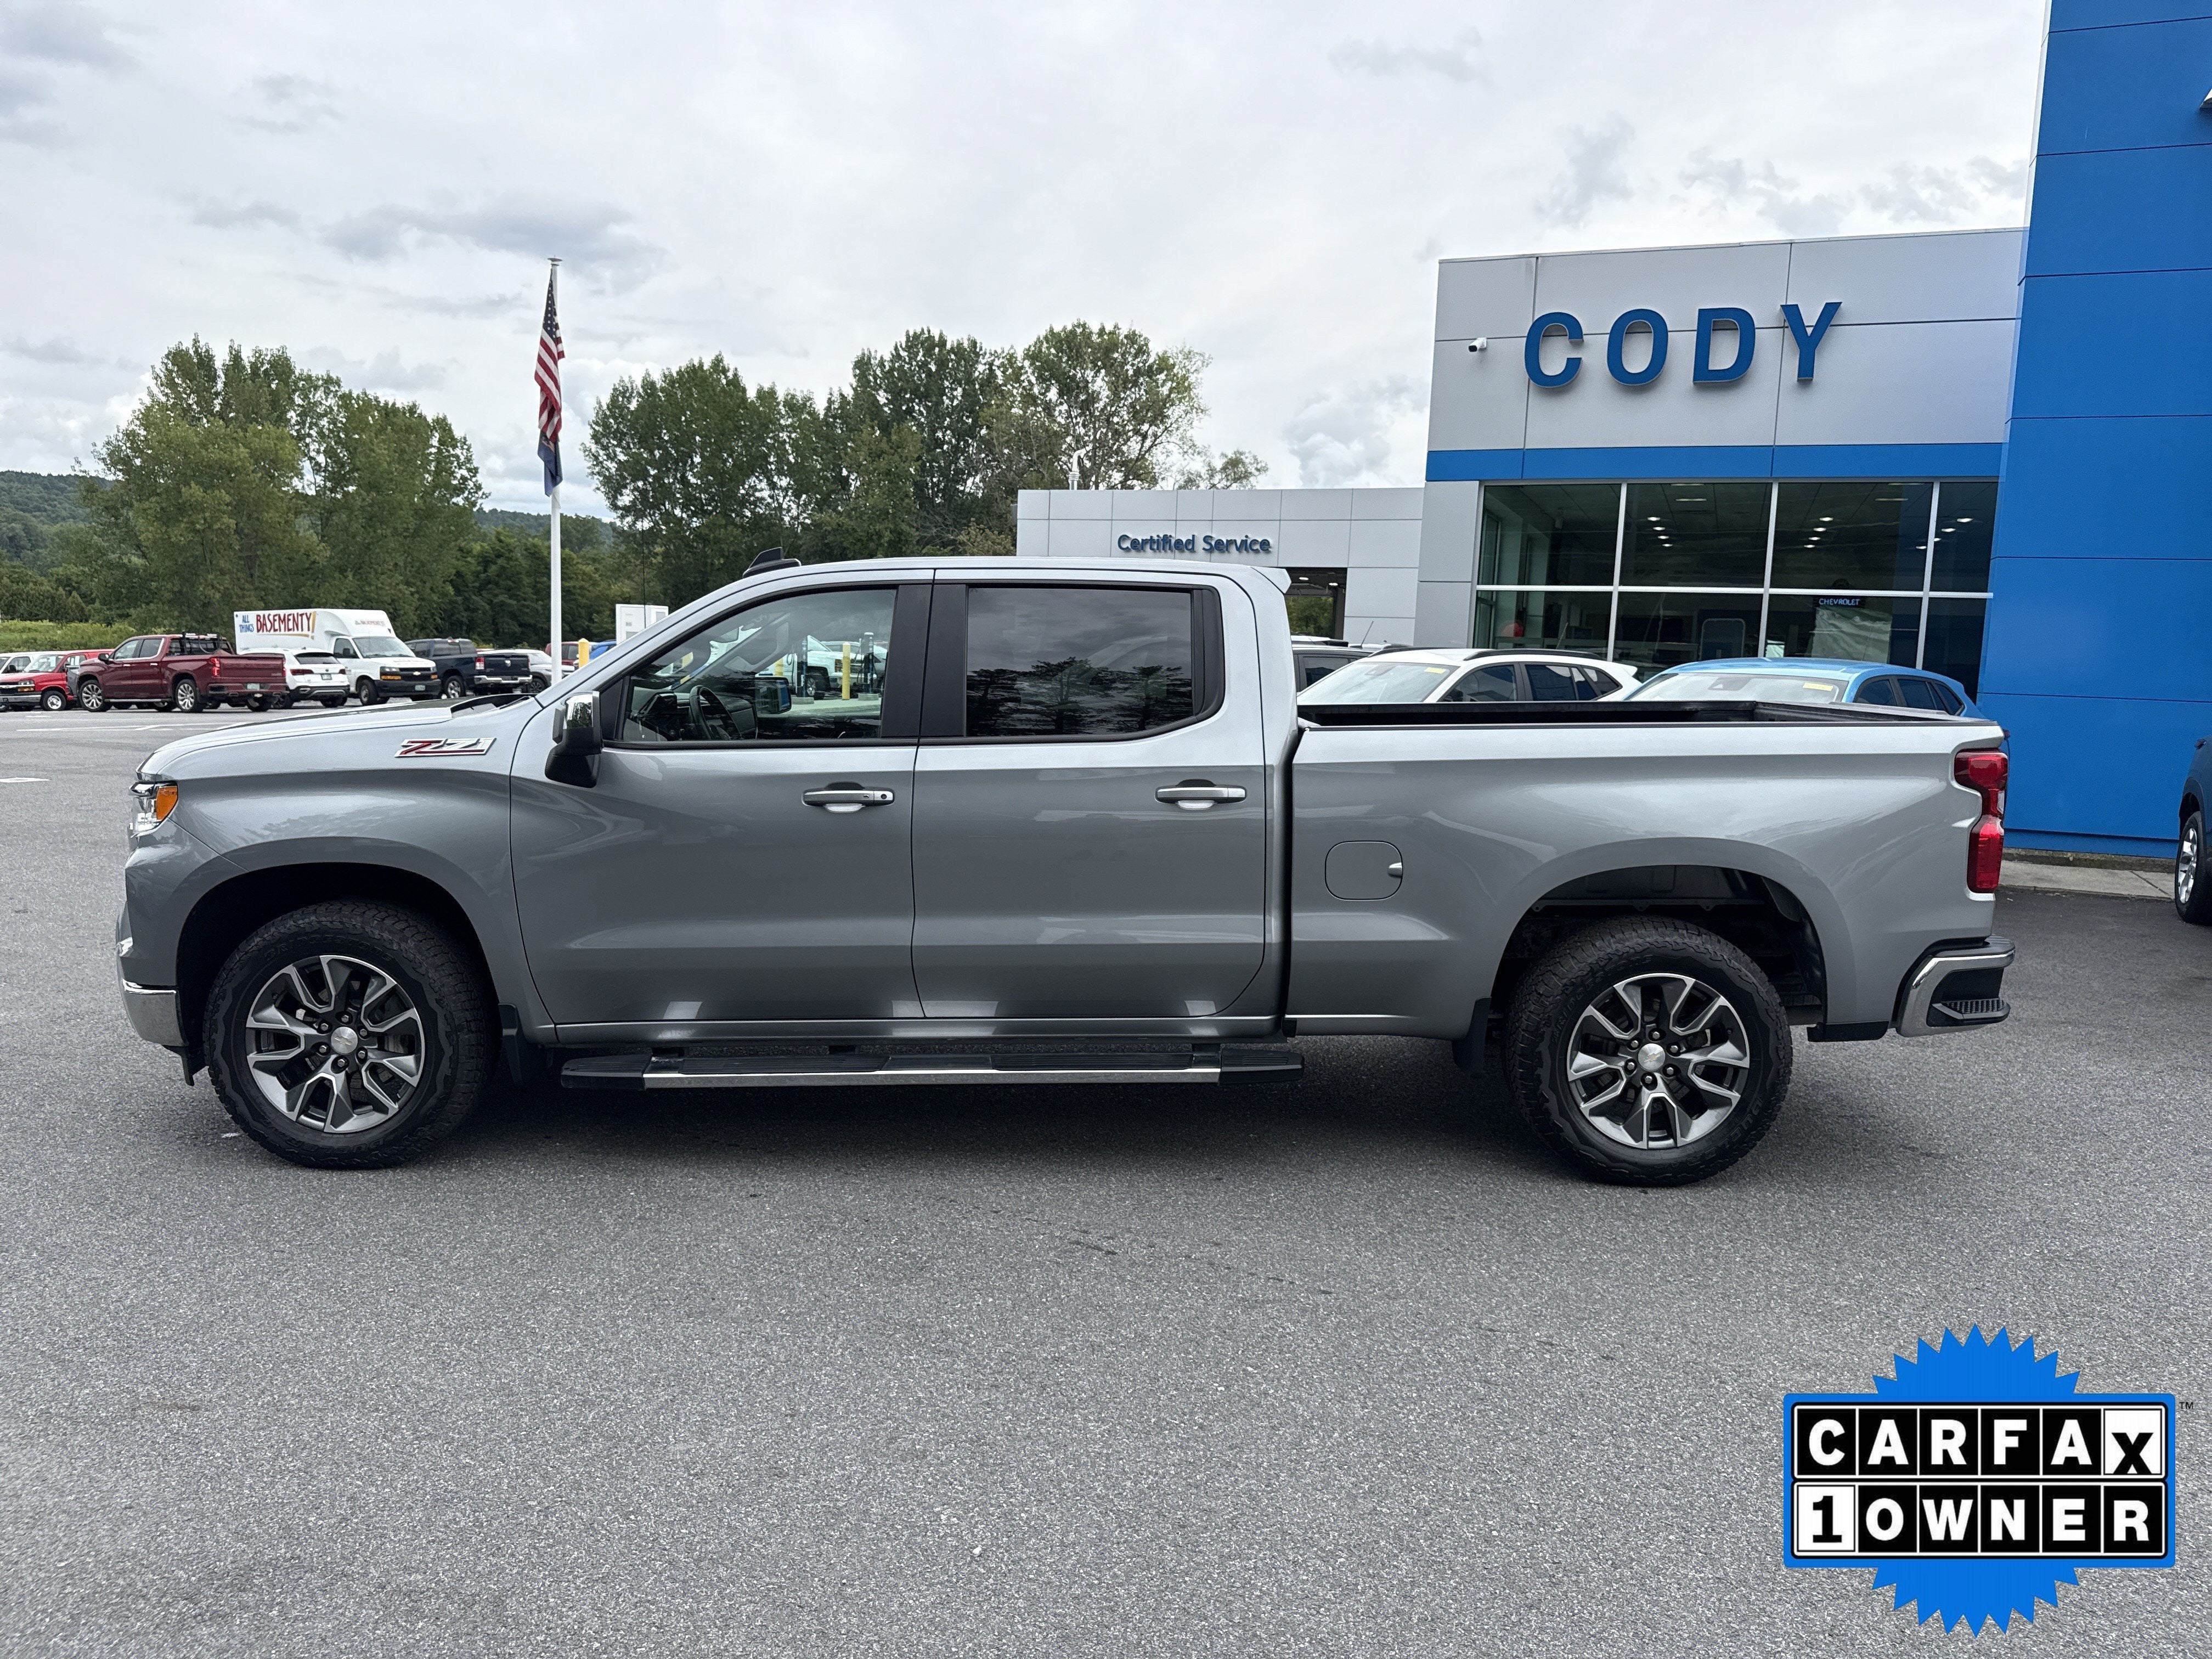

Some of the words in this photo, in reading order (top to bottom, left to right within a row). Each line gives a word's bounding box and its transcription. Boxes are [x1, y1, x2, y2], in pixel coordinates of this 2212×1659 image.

[1525, 302, 1843, 388] CODY
[1118, 534, 1195, 552] Certified
[1202, 535, 1271, 553] Service
[239, 623, 255, 633] THINGS
[394, 737, 497, 758] Z71
